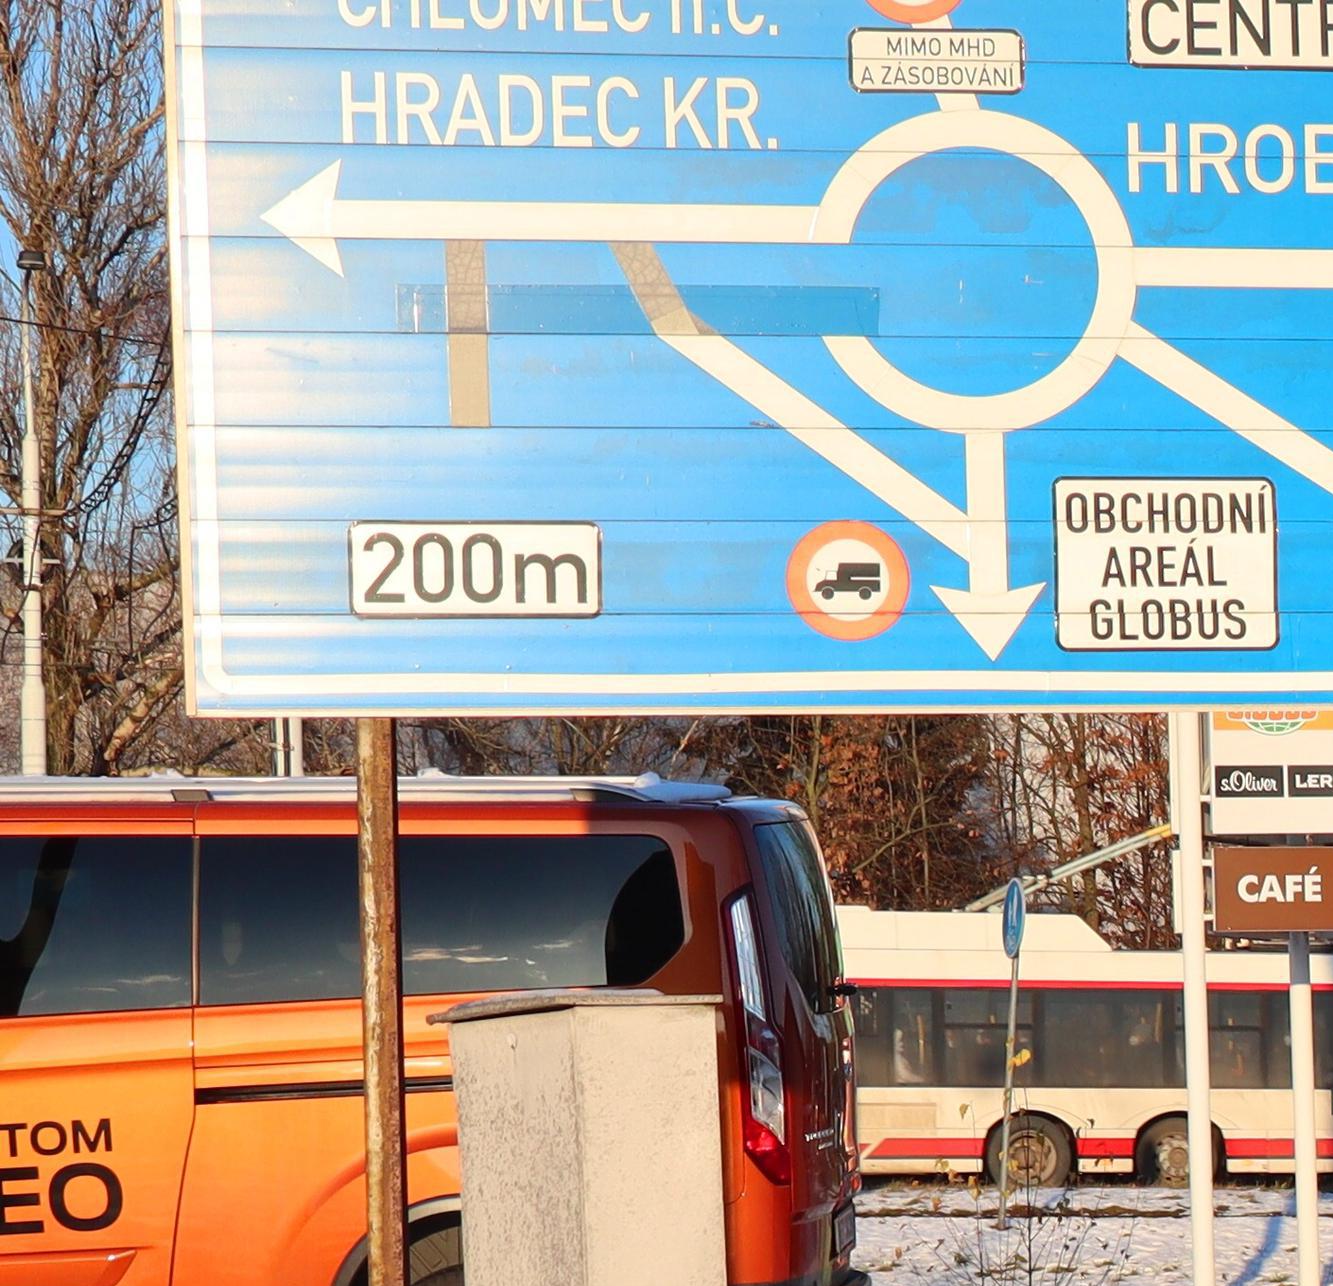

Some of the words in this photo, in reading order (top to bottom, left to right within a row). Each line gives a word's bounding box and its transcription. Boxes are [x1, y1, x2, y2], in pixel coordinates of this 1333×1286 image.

[886, 37, 942, 57] MIMO
[949, 37, 996, 58] MHD
[861, 66, 875, 85] A
[881, 62, 1015, 87] ZÁSOBOVÁNÍ
[339, 70, 641, 148] HRADEC
[663, 76, 779, 150] KR.
[1065, 484, 1268, 534] OBCHODNÍ
[362, 531, 588, 604] 200m
[1101, 537, 1228, 588] AREÁL
[1088, 598, 1247, 641] GLOBUS
[1237, 865, 1323, 903] CAFÉ
[0, 1118, 113, 1158] TOM
[0, 1162, 124, 1236] EO
